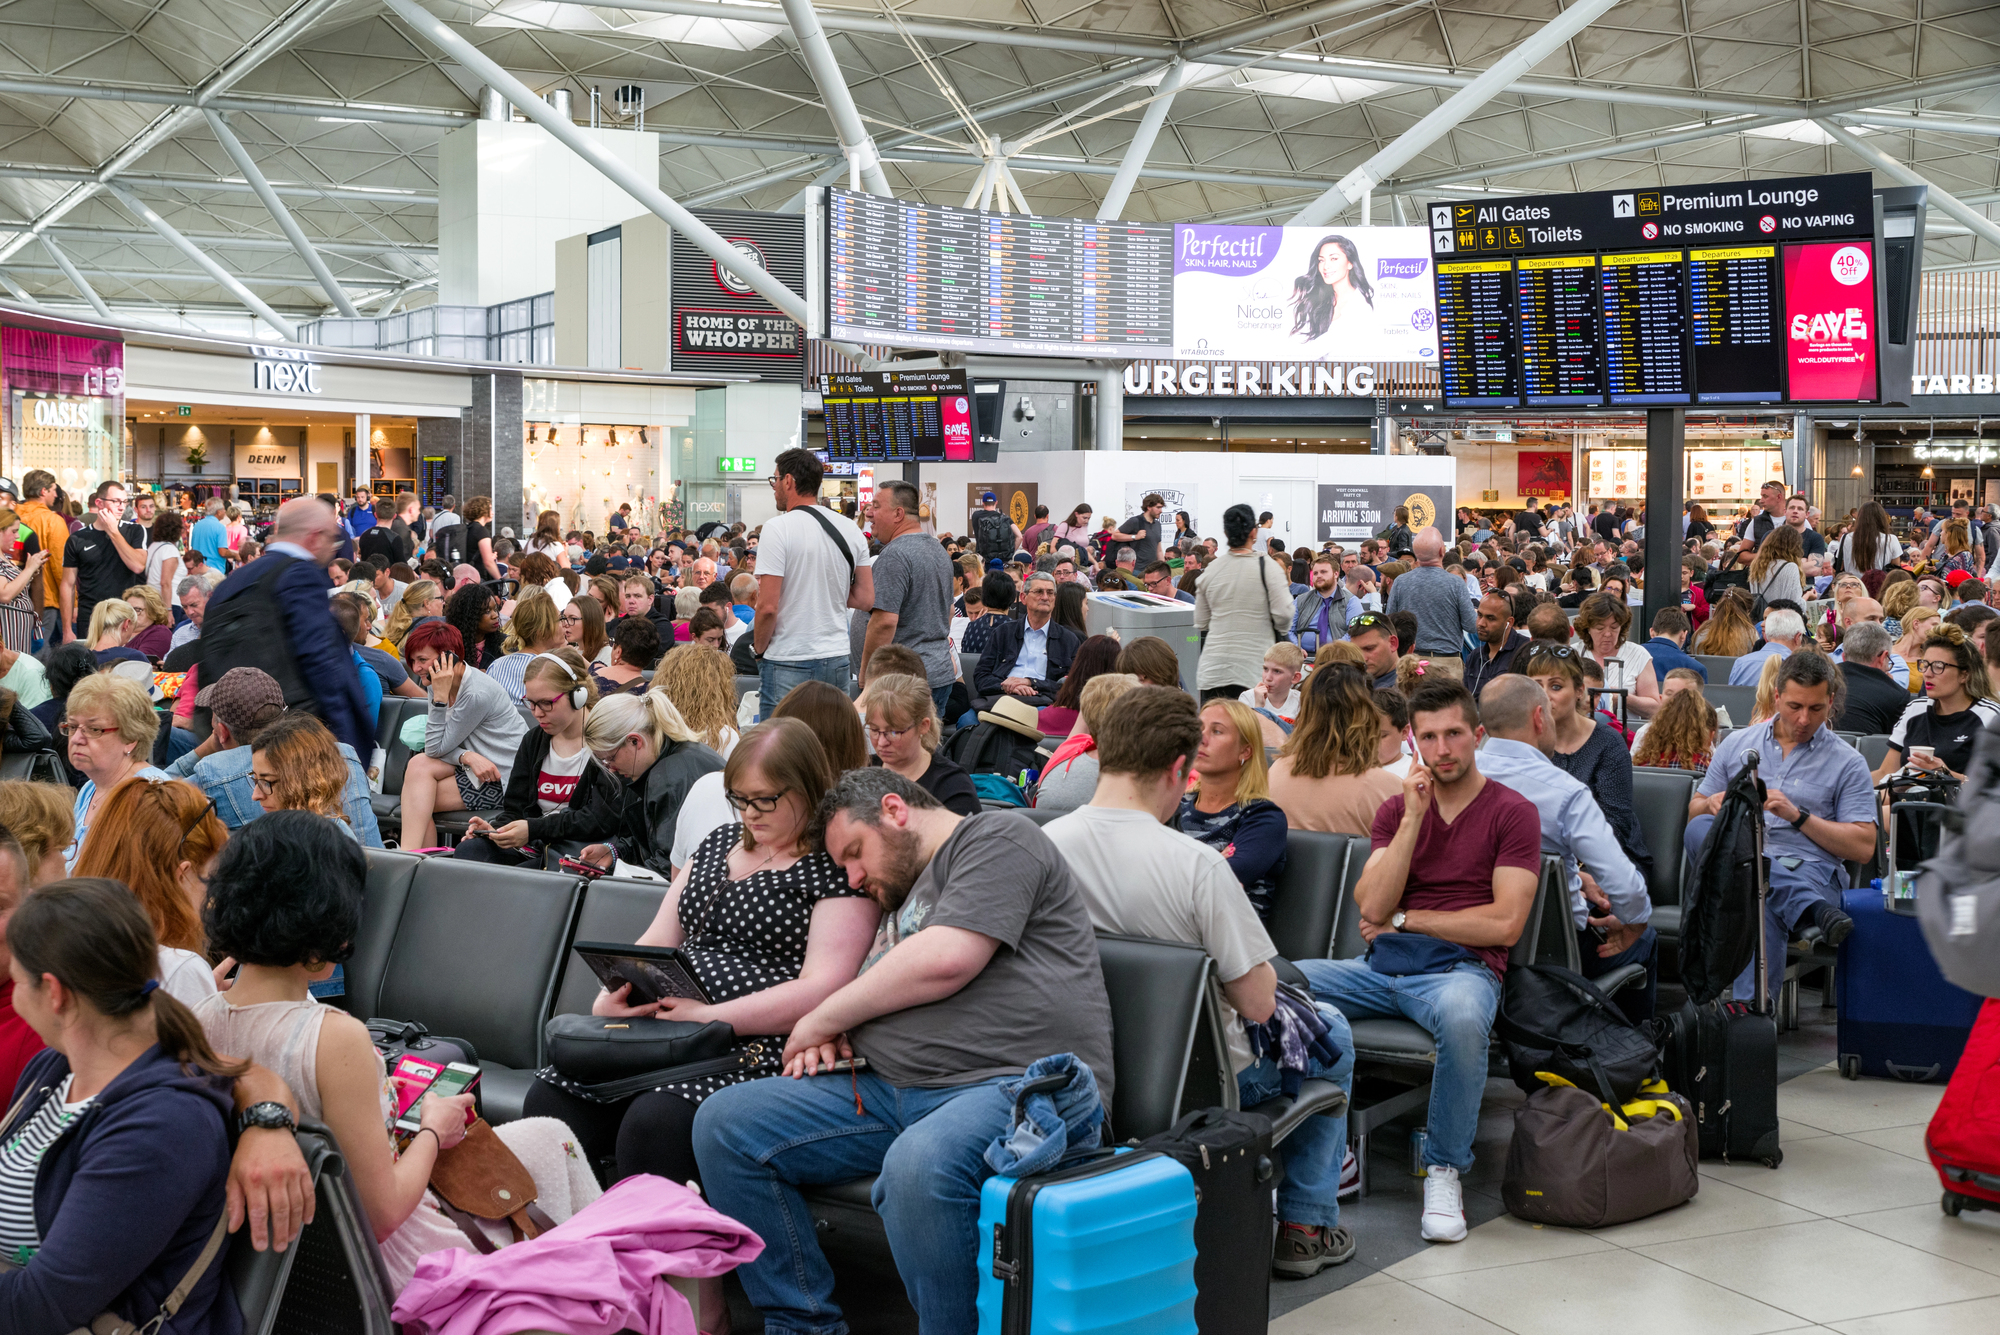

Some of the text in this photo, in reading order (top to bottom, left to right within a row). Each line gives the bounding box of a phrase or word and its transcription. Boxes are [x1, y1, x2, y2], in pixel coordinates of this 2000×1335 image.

[1663, 188, 1819, 212] Premium Lounge
[1477, 205, 1550, 223] All Gates
[1782, 213, 1855, 228] NO VAPING
[1527, 227, 1582, 243] Toilets
[1663, 220, 1744, 236] NO SMOKING
[1181, 228, 1267, 261] Perfectil
[1613, 255, 1650, 263] Departures
[1702, 250, 1741, 259] Departures
[1836, 255, 1864, 267] 40%
[1185, 258, 1257, 268] SKIN, HAIR, NAILS
[1379, 260, 1425, 277] Perfectil
[1840, 267, 1858, 275] Off
[1237, 304, 1283, 319] Nicole
[686, 316, 796, 332] HOME OF THE
[1237, 320, 1282, 331] Scherzinger
[1792, 312, 1863, 336] SAVE
[686, 330, 796, 349] WHOPPER
[831, 326, 847, 338] 17:29
[254, 360, 322, 394] next
[844, 375, 862, 383] Gates
[899, 373, 950, 382] Premium Lounge
[1271, 365, 1374, 396] KING
[1911, 374, 2000, 395] TARB
[854, 385, 874, 393] Toilets
[34, 400, 89, 429] OASIS
[945, 423, 969, 436] SAVE
[247, 454, 287, 464] DENIM
[690, 502, 722, 513] next
[1322, 510, 1381, 523] ARRIVING SOON
